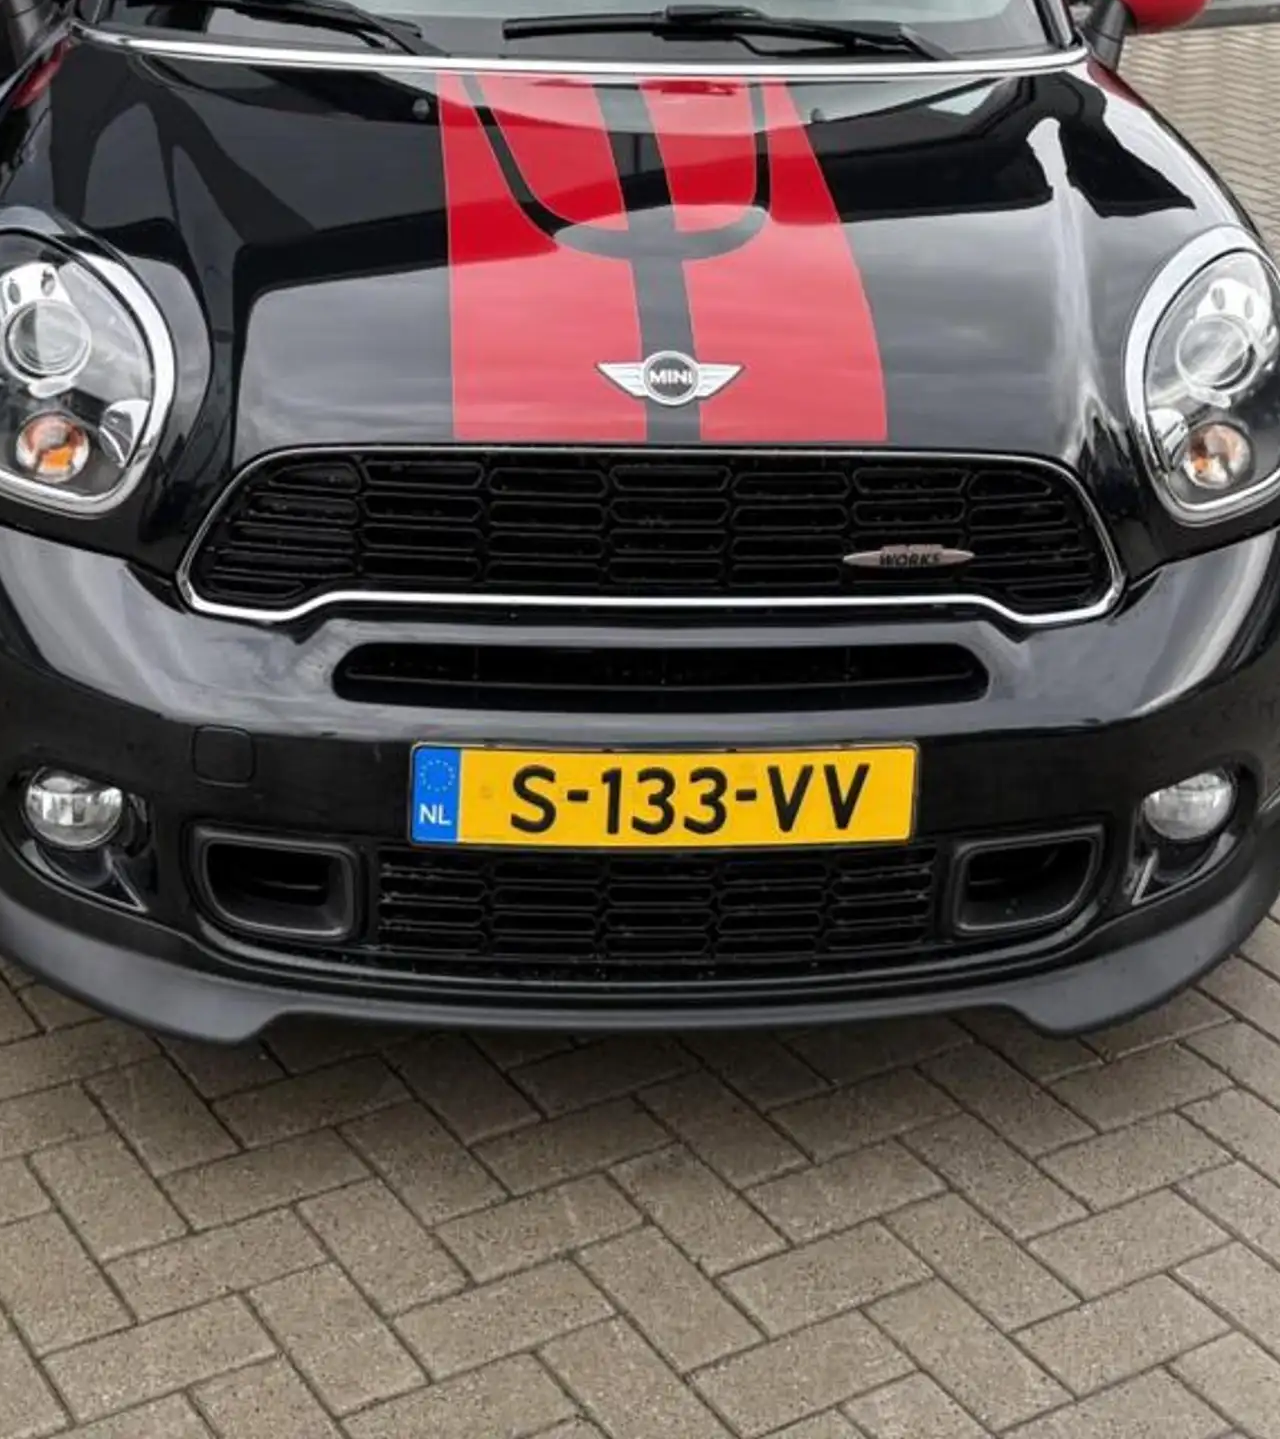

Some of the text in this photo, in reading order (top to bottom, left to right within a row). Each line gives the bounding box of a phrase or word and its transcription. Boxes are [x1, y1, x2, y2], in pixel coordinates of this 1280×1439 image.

[649, 369, 693, 385] MINI
[879, 552, 942, 566] WORKS
[419, 763, 871, 836] NL S-133-VV
